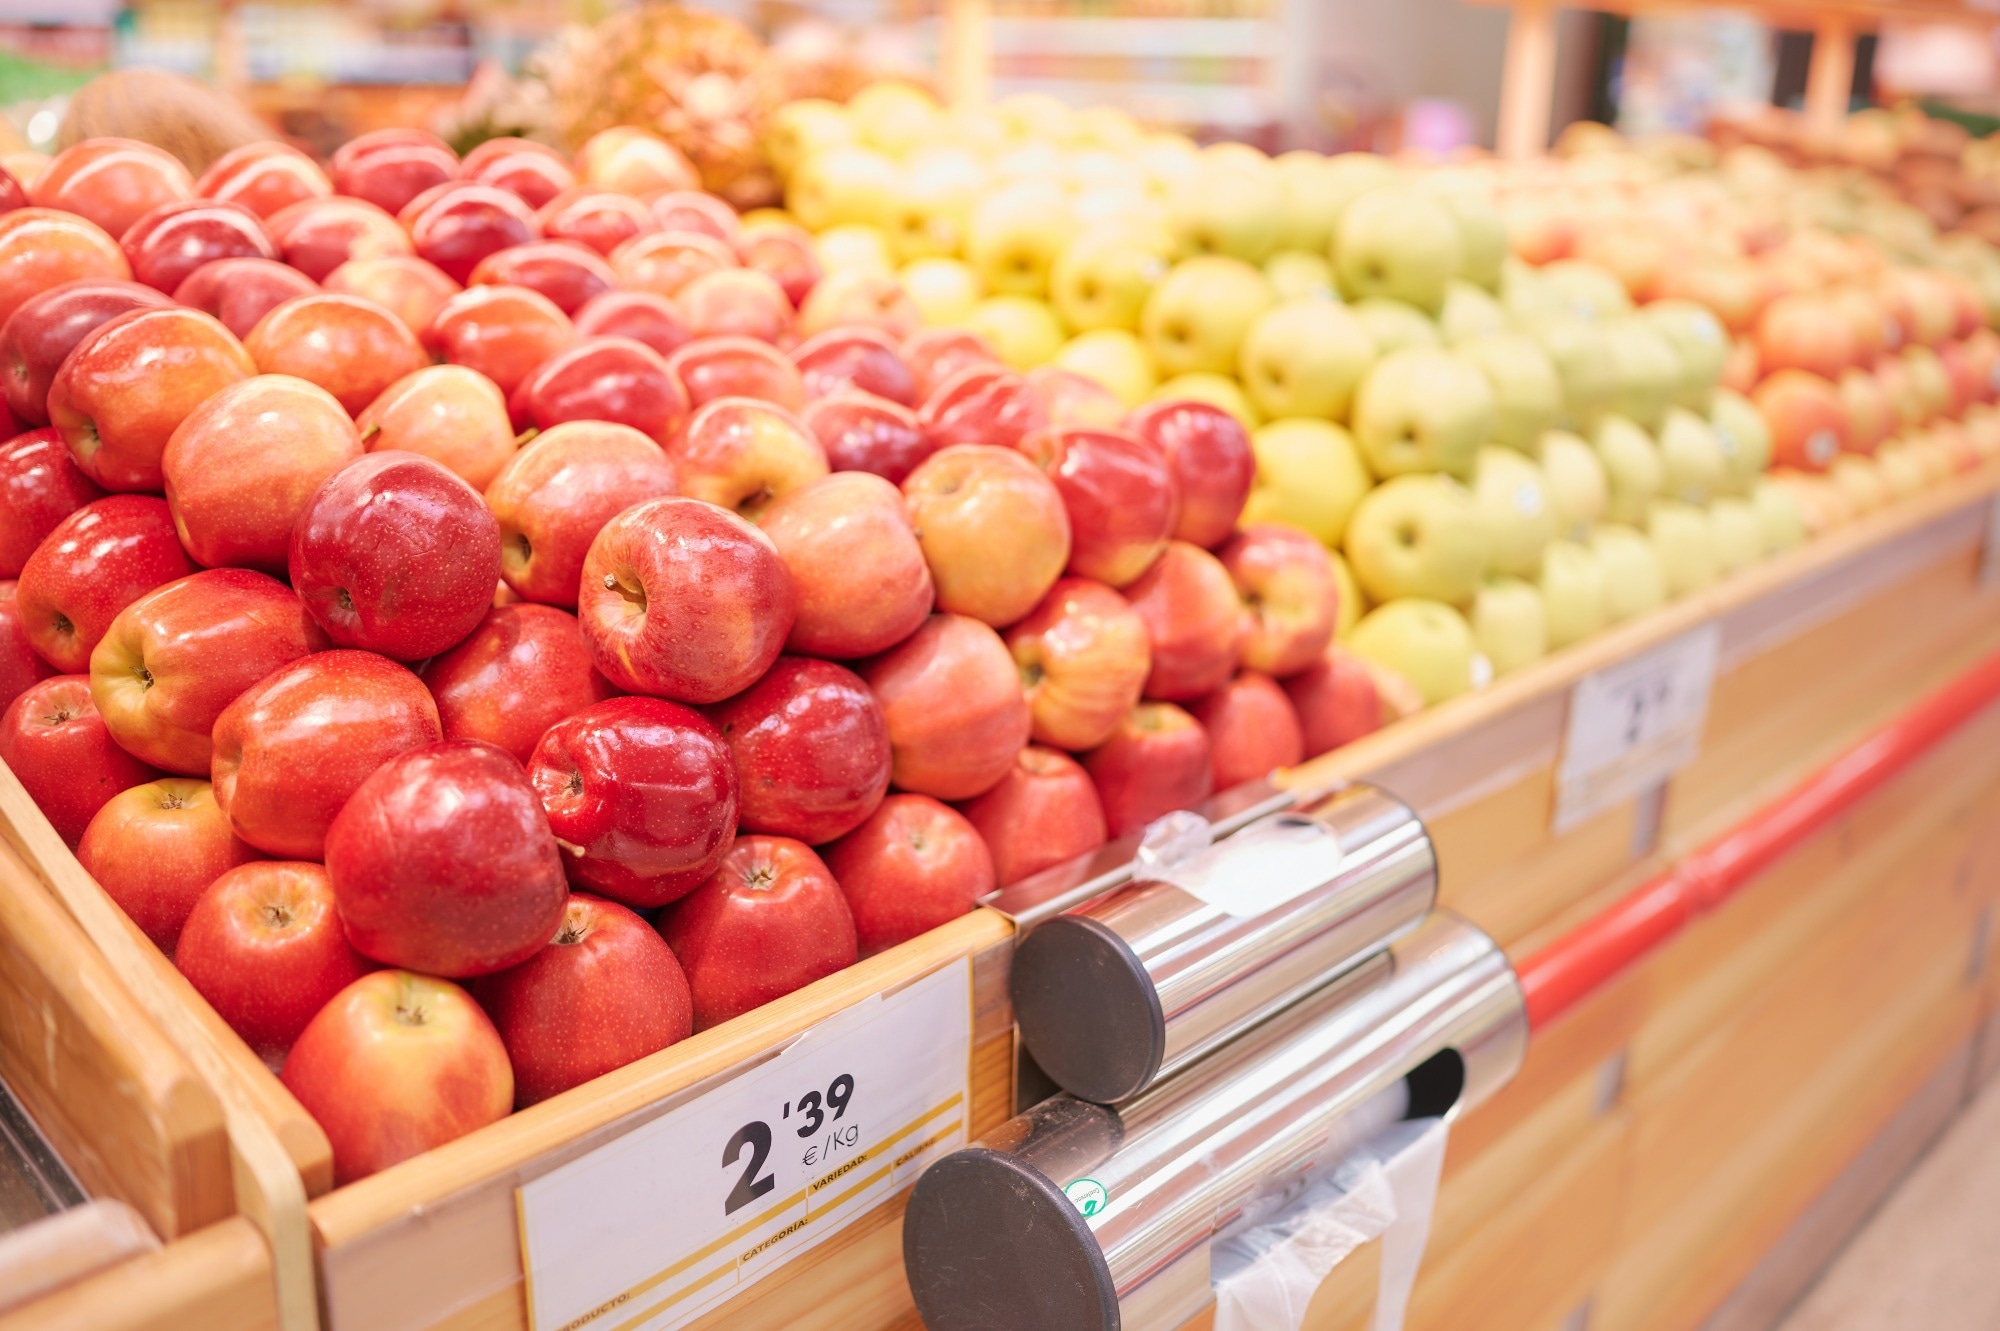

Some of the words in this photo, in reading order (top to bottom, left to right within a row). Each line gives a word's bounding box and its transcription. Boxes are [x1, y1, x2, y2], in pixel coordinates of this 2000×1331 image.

[812, 1154, 868, 1191] VARIEDAD:
[742, 1218, 808, 1262] CATEGORÍA:
[556, 1292, 631, 1331] RODUCTO:
